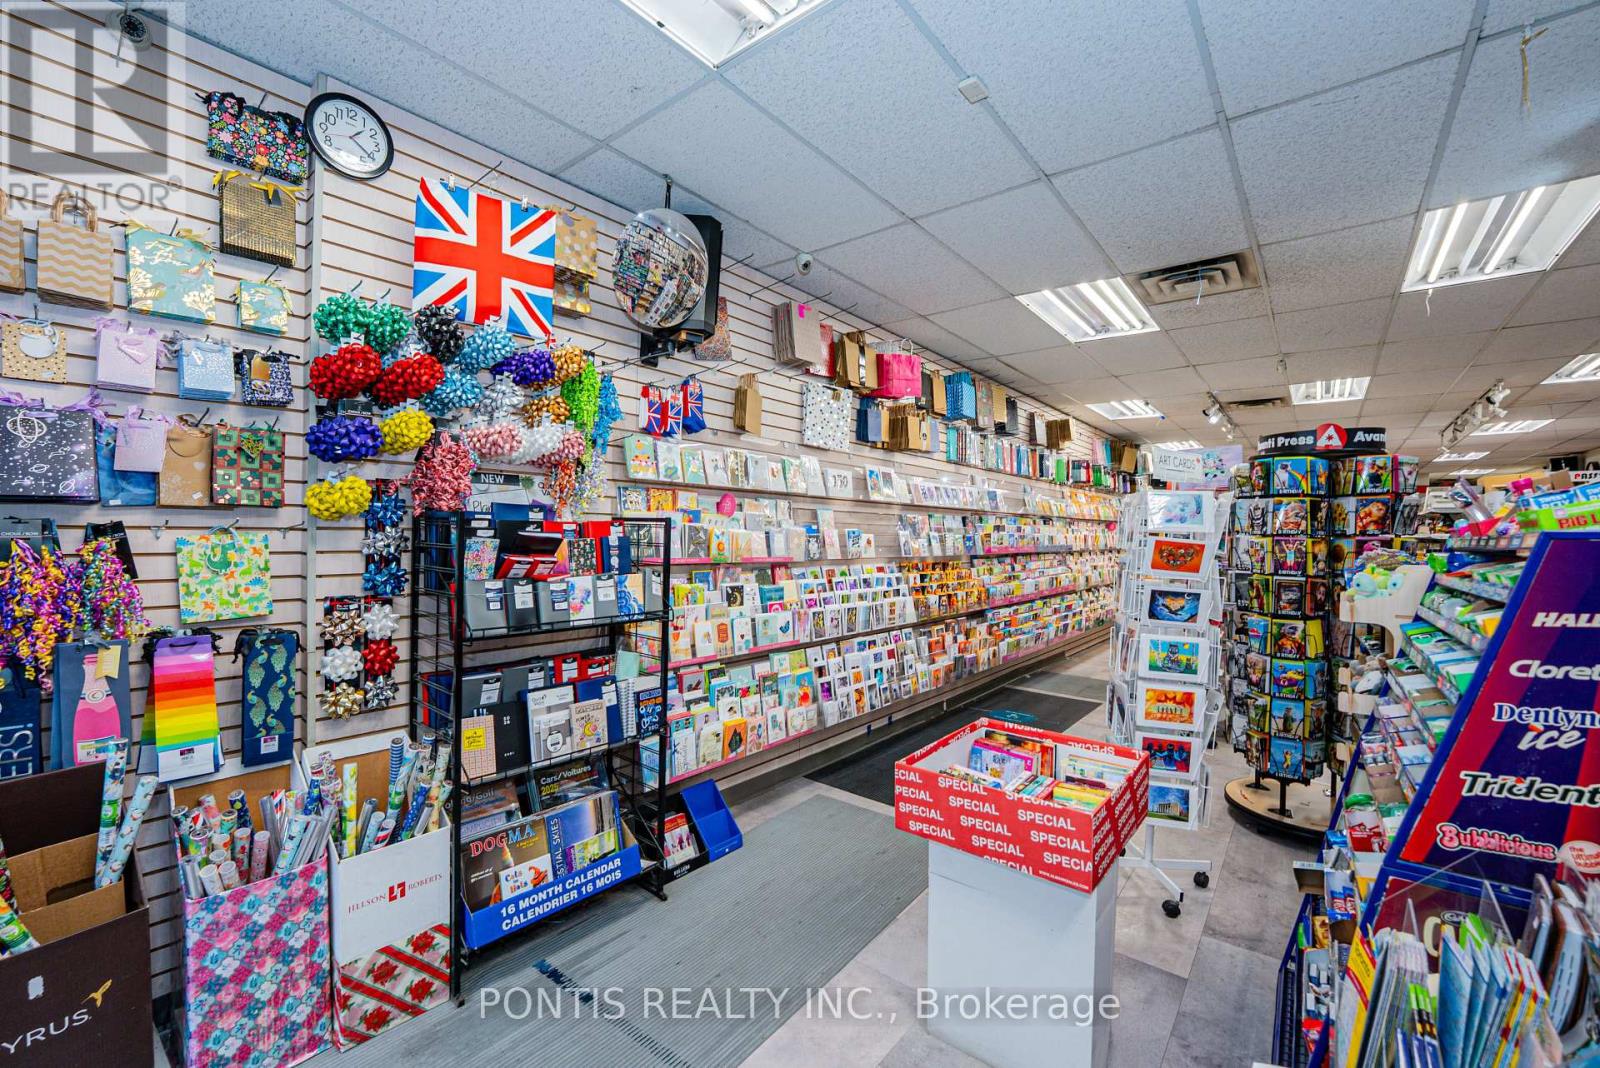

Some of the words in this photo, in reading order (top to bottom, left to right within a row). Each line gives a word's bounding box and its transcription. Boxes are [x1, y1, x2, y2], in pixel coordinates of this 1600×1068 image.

[323, 111, 337, 126] 10
[335, 106, 343, 120] 11
[345, 107, 358, 121] 12
[362, 116, 366, 128] 1
[319, 122, 329, 134] 9
[369, 128, 378, 140] 2
[323, 135, 333, 147] 8
[373, 141, 381, 153] 3
[1277, 436, 1314, 448] Press
[481, 474, 505, 484] NEW
[1517, 724, 1587, 750] ice
[540, 765, 592, 785] Cars/Voitures
[540, 783, 560, 796] 2025
[938, 776, 988, 796] SPECIAL
[899, 802, 945, 822] SPECIAL
[948, 796, 1000, 816] SPECIAL
[960, 815, 1013, 837] SPECIAL
[1017, 809, 1077, 831] SPECIAL
[550, 817, 562, 846] SKIES
[909, 820, 956, 841] SPECIAL
[470, 824, 537, 858] DOGMA
[971, 835, 1025, 858] SPECIAL
[1030, 830, 1091, 854] SPECIAL
[1436, 822, 1558, 863] Bubblicious
[348, 893, 387, 914] JILLSON
[408, 873, 443, 891] ROBERTS
[500, 903, 516, 918] 16
[519, 883, 563, 911] MONTH
[565, 858, 621, 890] CALENDAR
[502, 889, 578, 931] CALENDRIER
[581, 884, 594, 896] 16
[596, 870, 622, 887] MOIS
